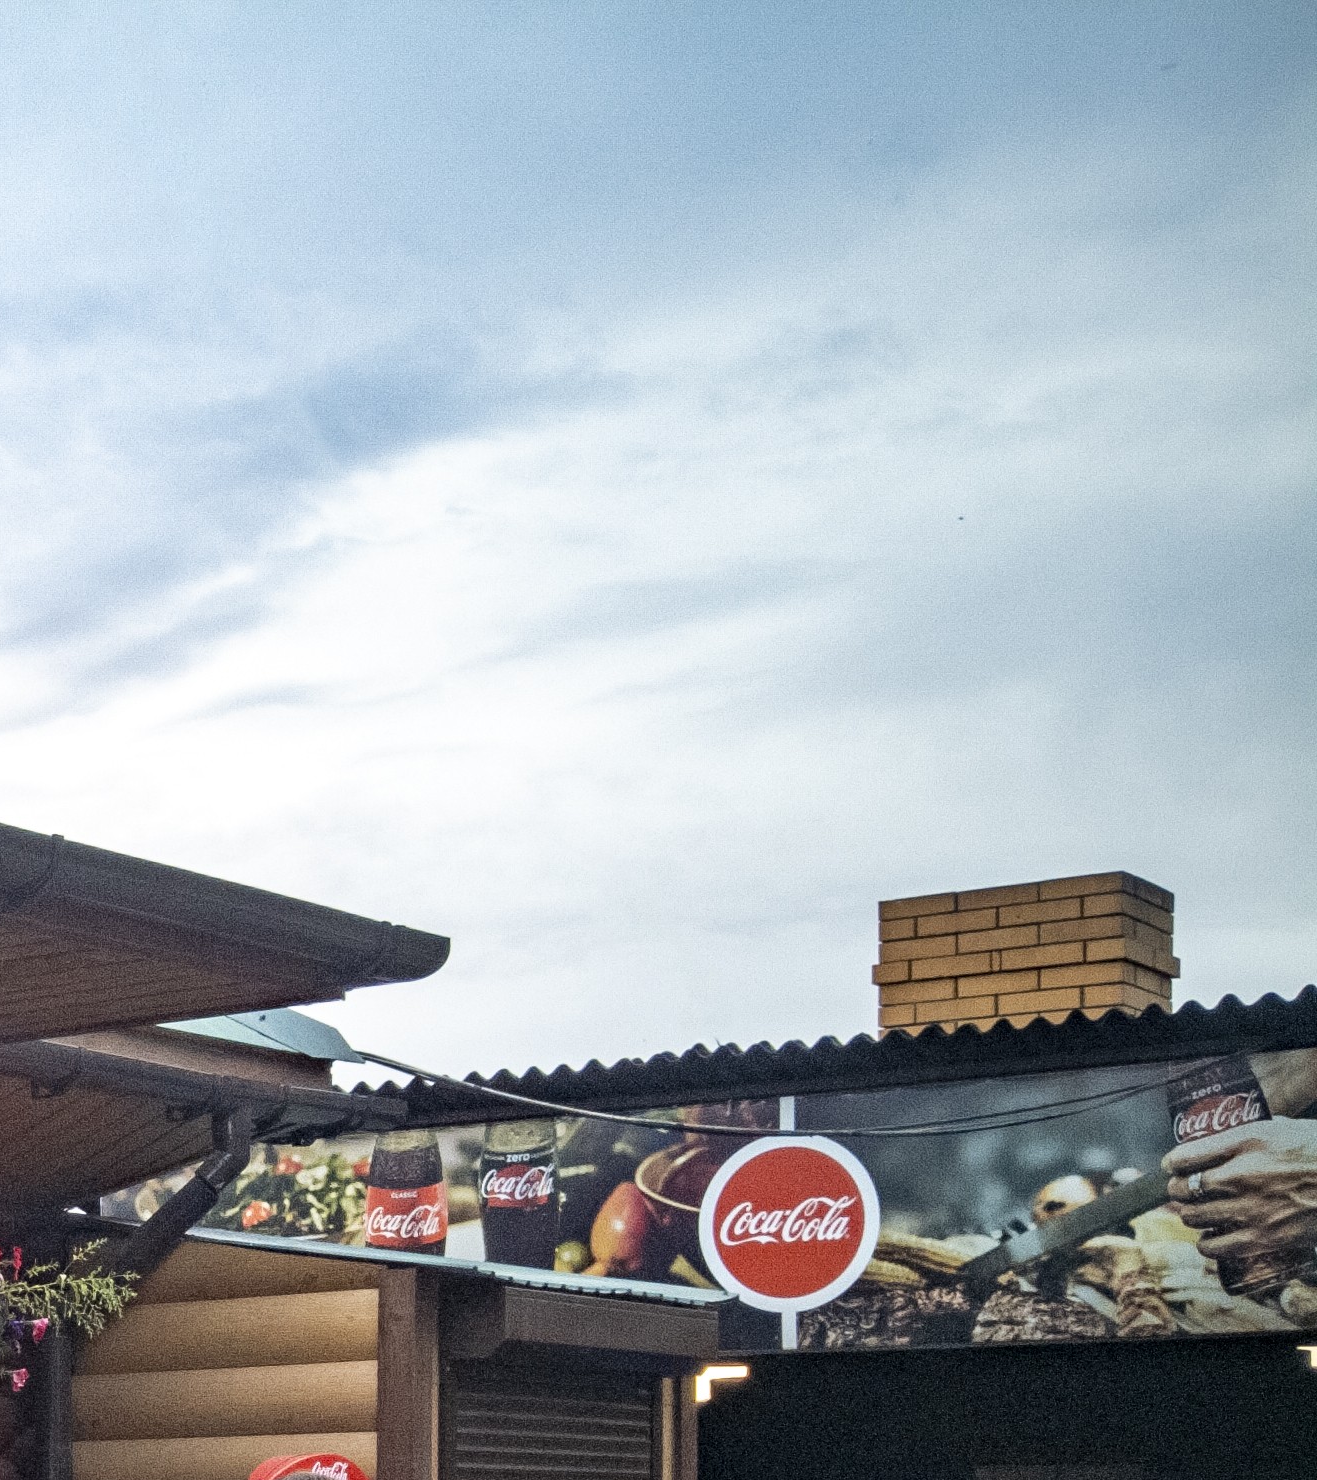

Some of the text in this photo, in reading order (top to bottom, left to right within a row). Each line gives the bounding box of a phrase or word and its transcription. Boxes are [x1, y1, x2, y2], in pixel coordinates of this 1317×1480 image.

[1173, 1090, 1261, 1143] Coca-Cola
[506, 1153, 531, 1163] zero
[481, 1163, 554, 1200] Coca-Cola
[368, 1202, 441, 1238] Coca-Cola
[719, 1195, 857, 1246] Coca-Cola
